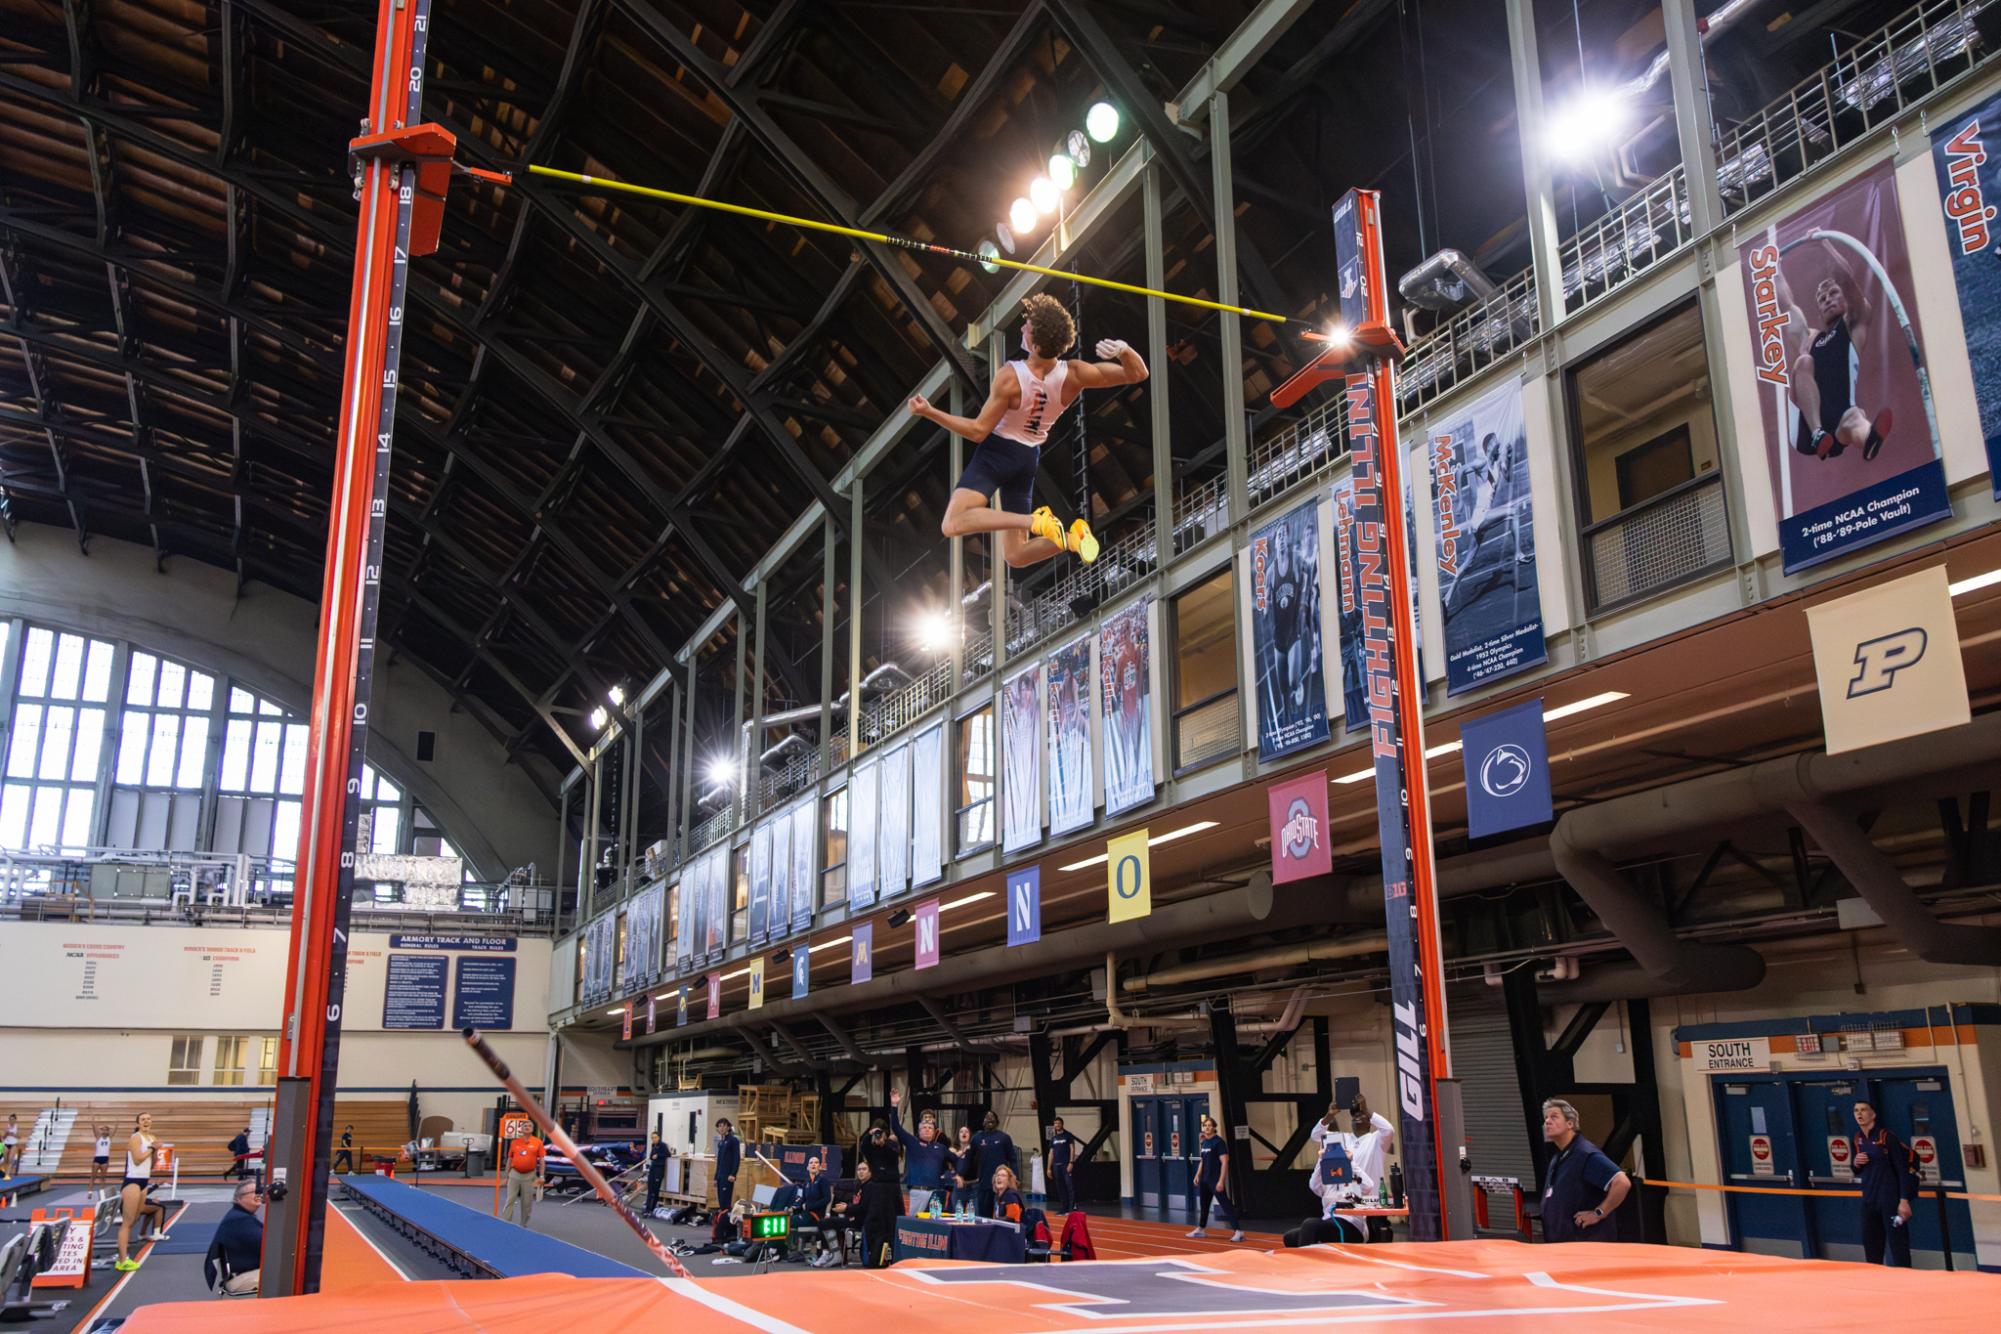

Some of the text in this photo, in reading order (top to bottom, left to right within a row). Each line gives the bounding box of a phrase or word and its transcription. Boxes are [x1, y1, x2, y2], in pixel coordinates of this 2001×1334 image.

[414, 15, 427, 32] 21
[409, 66, 422, 92] 20
[400, 185, 412, 204] 18
[1944, 118, 1998, 256] Virgin
[1334, 198, 1352, 224] GILL
[1356, 232, 1364, 247] 21
[394, 246, 407, 264] 17
[1360, 276, 1368, 297] 20
[389, 307, 402, 326] 16
[1749, 243, 1790, 388] Starkey
[383, 369, 396, 388] 15
[1367, 373, 1375, 389] 18
[1371, 421, 1379, 437] 17
[377, 432, 391, 453] 14
[1345, 371, 1377, 510] ILLINI
[1375, 471, 1383, 487] 16
[371, 498, 384, 517] 13
[1434, 433, 1461, 577] McKenley
[1801, 486, 1920, 537] 2-time NCAA Champion
[1880, 502, 1911, 521] Vault)
[1379, 522, 1386, 538] 15
[1336, 489, 1355, 613] Lehmann
[365, 564, 380, 584] 12
[1383, 573, 1391, 590] 14
[1356, 521, 1397, 758] FIGHTING
[1387, 626, 1395, 641] 13
[360, 638, 373, 649] 11
[1476, 643, 1512, 660] 1952 Olympics
[1483, 658, 1498, 667] NCAA
[1498, 647, 1524, 660] Champion
[1845, 626, 1928, 700] P
[1392, 679, 1399, 696] 12
[353, 703, 367, 725] 10
[1396, 737, 1404, 746] 11
[347, 778, 360, 794] 9
[1401, 788, 1408, 807] 10
[341, 851, 354, 868] 8
[1405, 847, 1413, 861] 9
[1016, 882, 1031, 932] N
[1410, 905, 1417, 918] 8
[333, 927, 347, 943] 7
[400, 935, 434, 944] ARMORY
[436, 936, 460, 944] TRACK
[463, 937, 480, 945] AND
[920, 915, 934, 955] N
[1414, 963, 1423, 977] 7
[752, 973, 760, 994] M
[327, 1004, 340, 1021] 6
[1419, 1024, 1427, 1038] 6
[1708, 1041, 1751, 1058] SOUTH
[1394, 999, 1424, 1122] GILL
[1708, 1057, 1754, 1069] ENTRANCE
